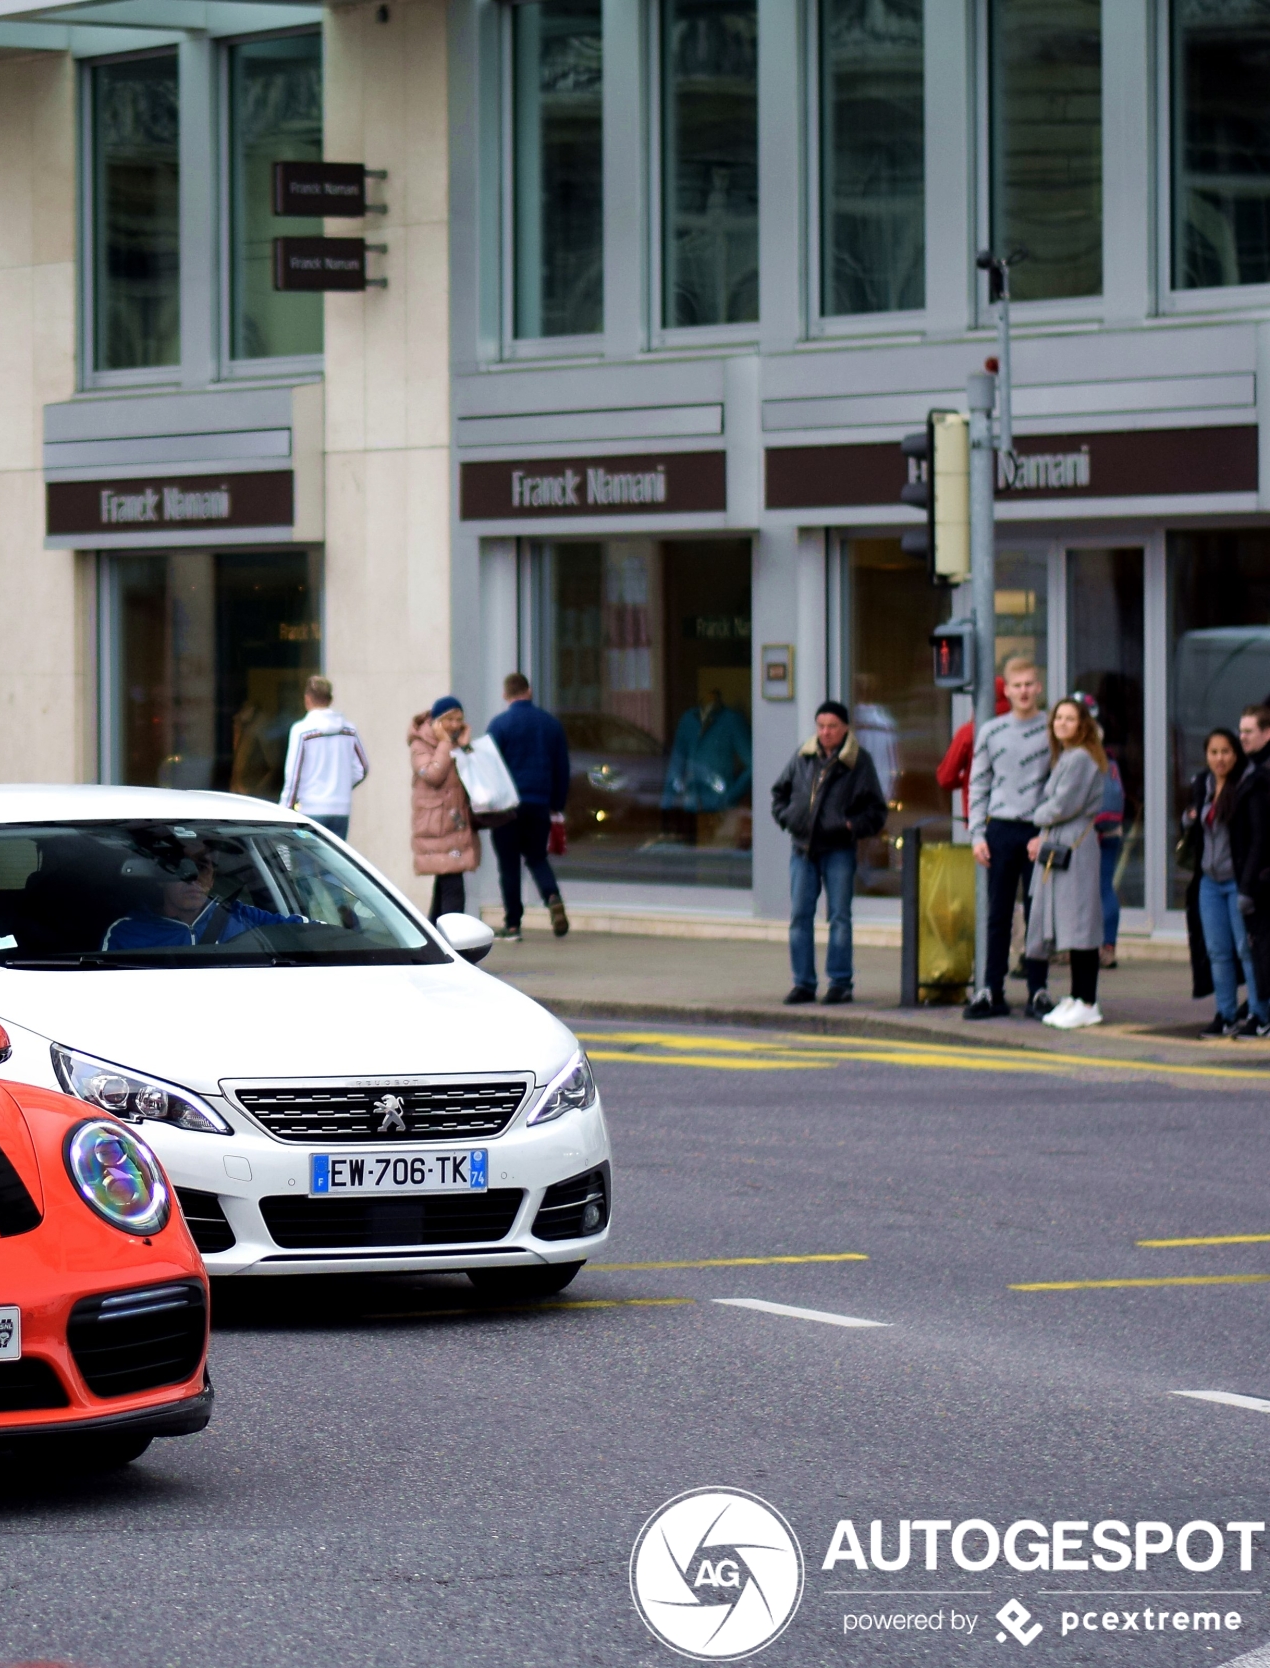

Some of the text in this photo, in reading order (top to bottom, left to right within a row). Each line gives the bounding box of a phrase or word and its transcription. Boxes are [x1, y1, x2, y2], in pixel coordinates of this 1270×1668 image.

[512, 465, 666, 507] Franck Namani
[100, 484, 229, 524] Franck Namani
[318, 1178, 324, 1187] F
[471, 1171, 485, 1185] 74
